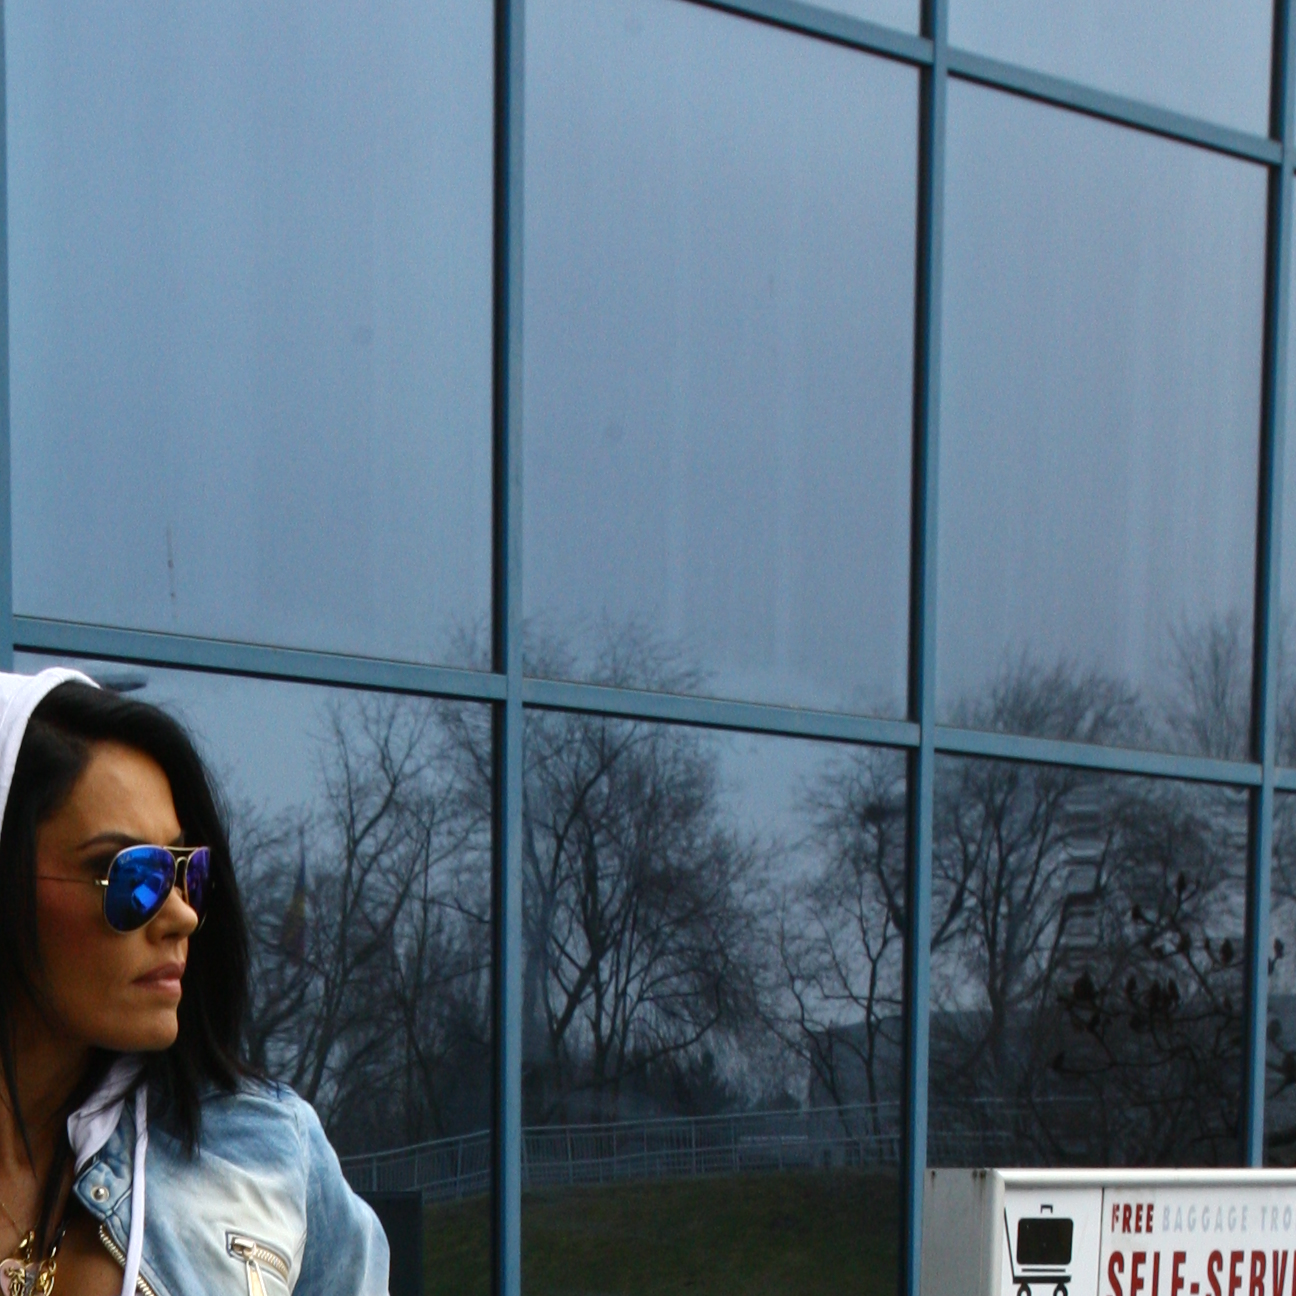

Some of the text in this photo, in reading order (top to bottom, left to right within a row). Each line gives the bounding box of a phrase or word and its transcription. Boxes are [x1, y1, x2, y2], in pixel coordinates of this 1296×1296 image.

[1111, 1203, 1296, 1234] FREE BAGGAGE TRO
